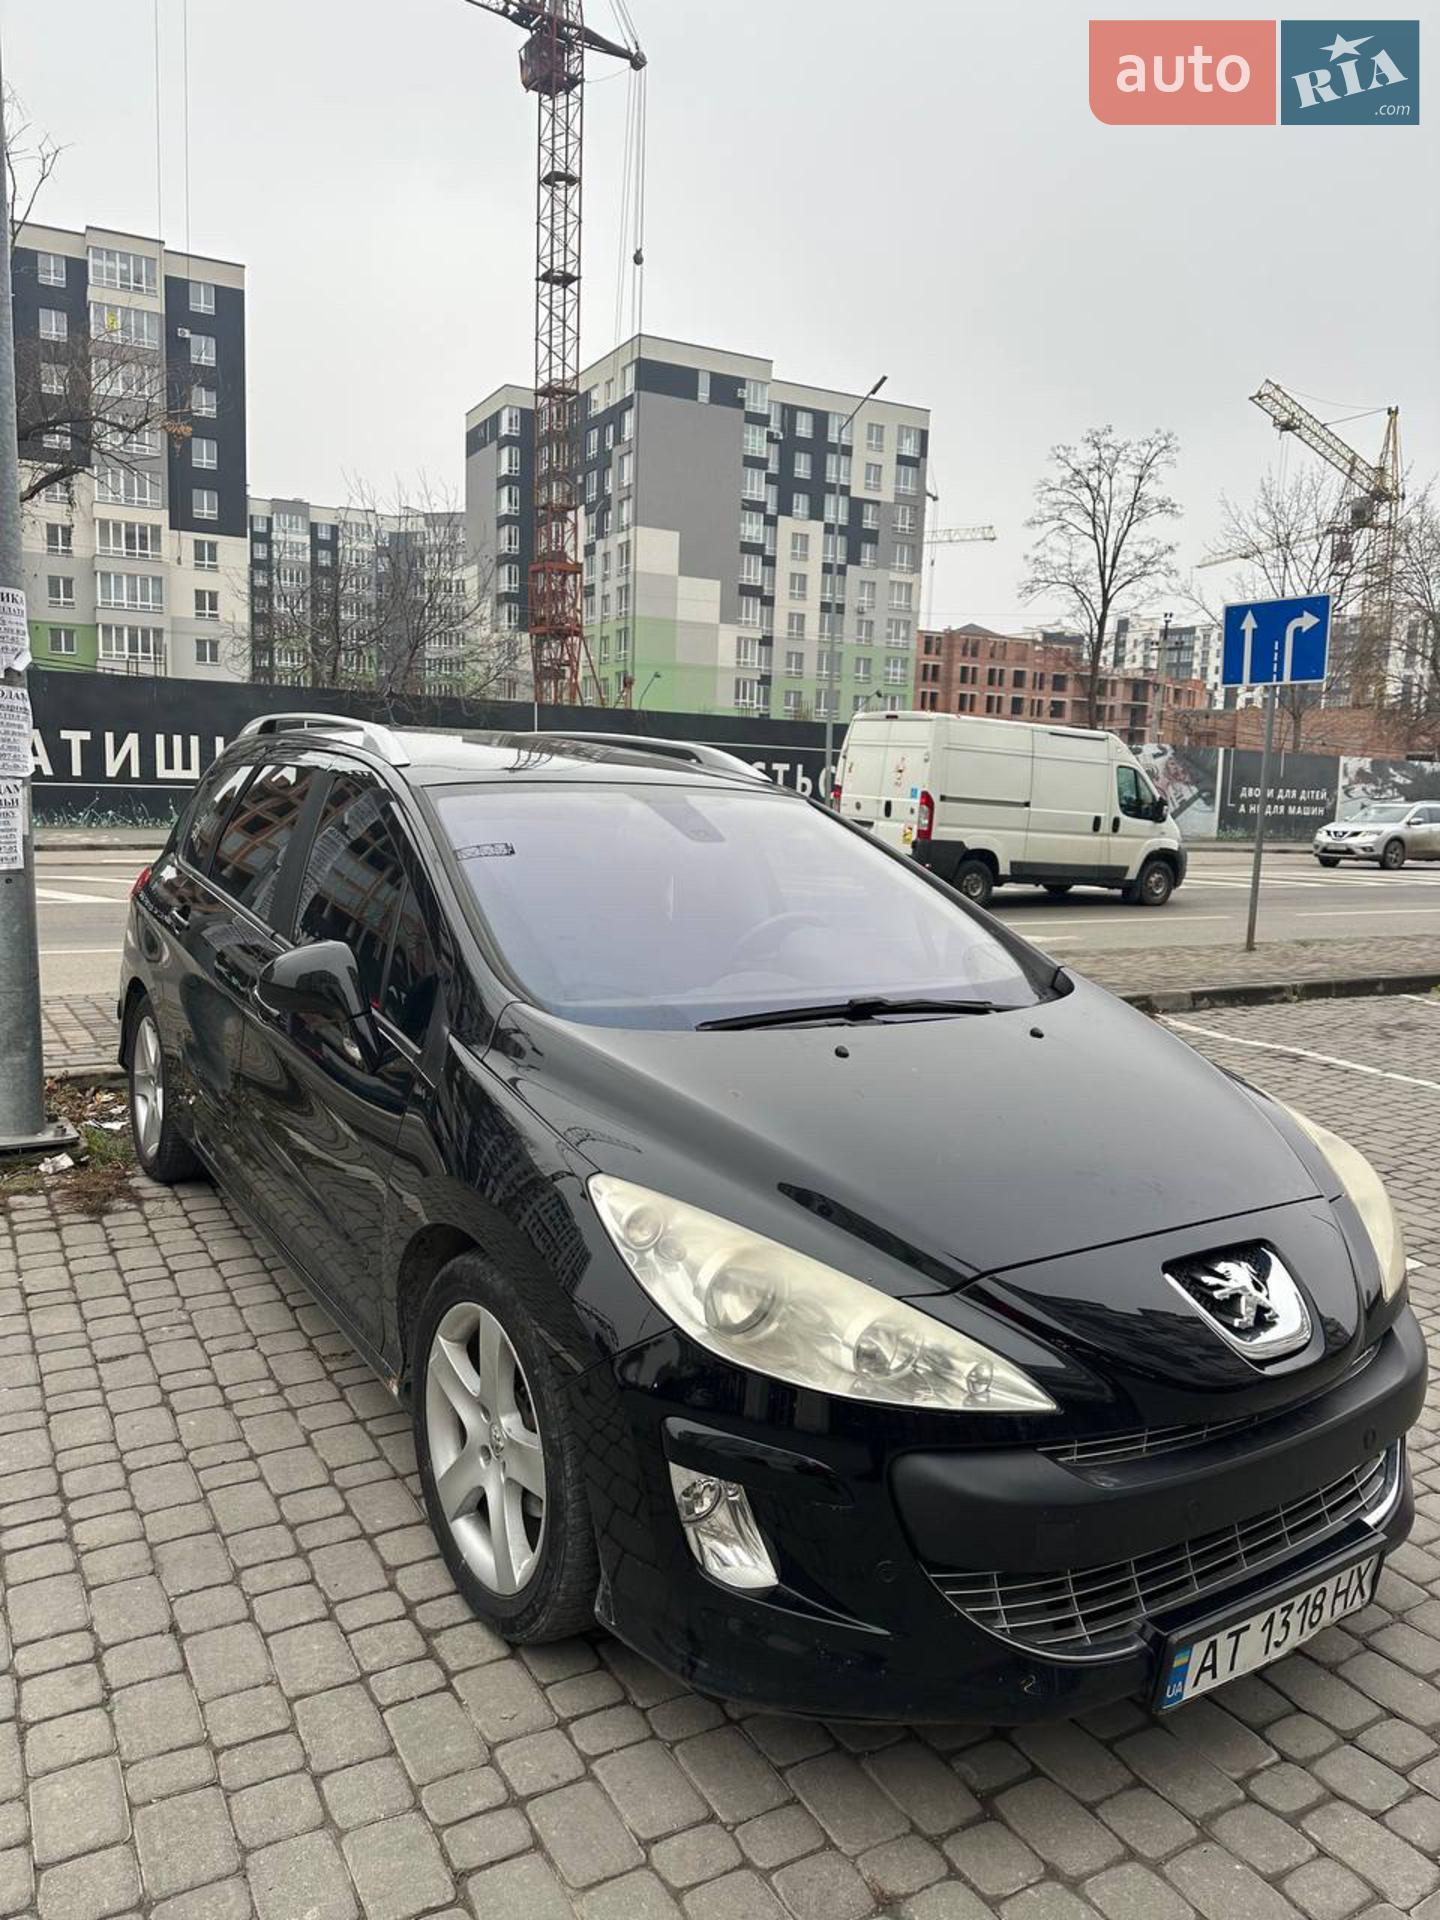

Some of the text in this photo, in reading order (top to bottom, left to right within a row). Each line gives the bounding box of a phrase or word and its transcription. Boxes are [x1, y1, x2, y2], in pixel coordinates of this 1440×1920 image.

[30, 728, 225, 780] АТИШ
[1240, 787, 1275, 799] ДВОИ
[1277, 788, 1297, 800] ДЛЯ
[1238, 804, 1246, 814] А
[1264, 804, 1285, 816] ДЛЯ
[1288, 805, 1325, 816] МАШИН
[1192, 1624, 1250, 1688] AT
[1260, 1586, 1327, 1656] 1318
[1166, 1681, 1183, 1698] UA
